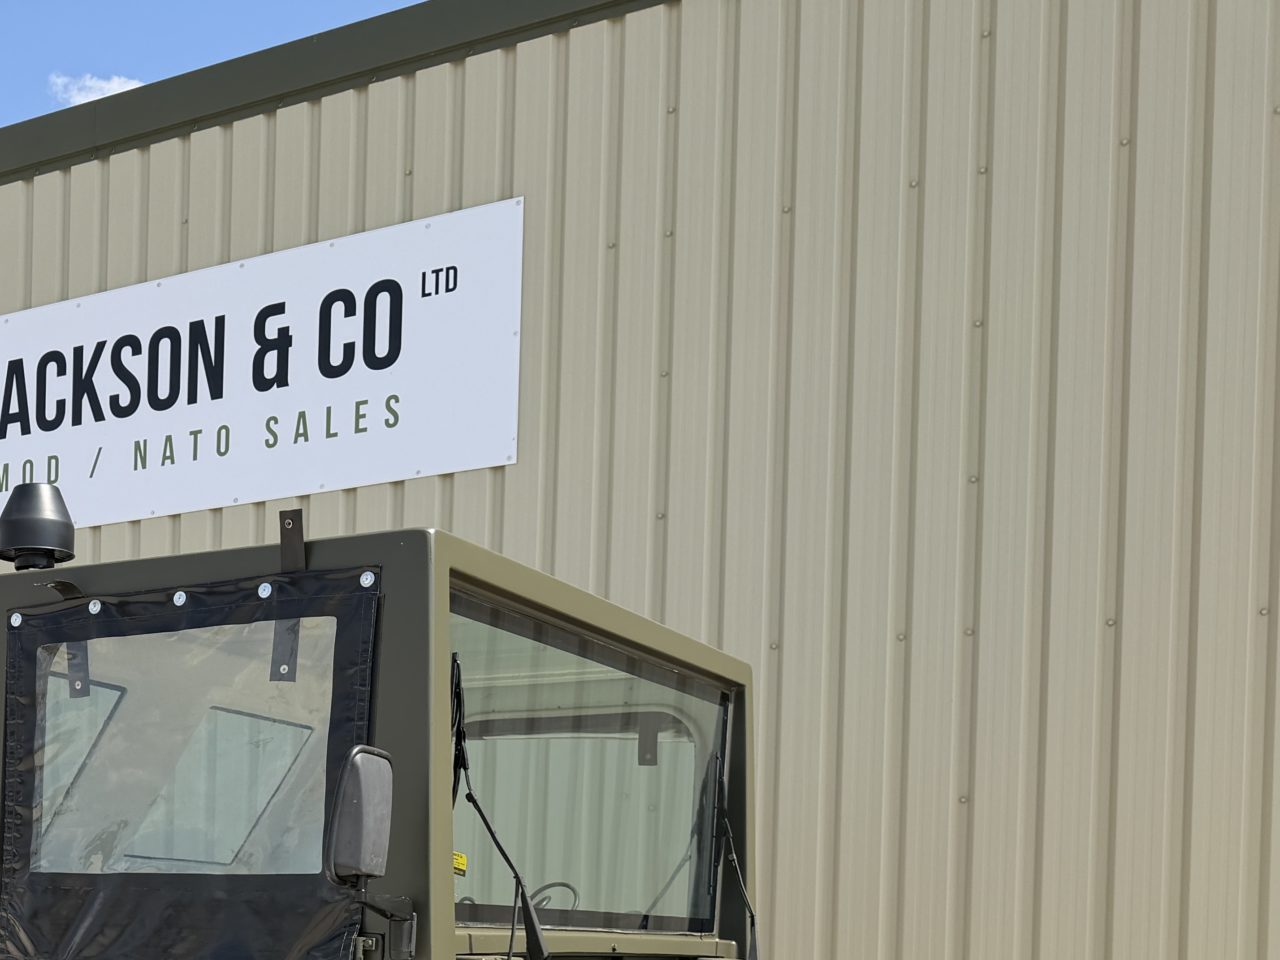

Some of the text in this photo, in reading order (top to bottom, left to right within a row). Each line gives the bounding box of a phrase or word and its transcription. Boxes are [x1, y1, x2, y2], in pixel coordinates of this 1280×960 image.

[251, 301, 293, 393] &
[317, 278, 404, 380] CO
[421, 265, 459, 299] LTD
[89, 446, 103, 479] /
[133, 424, 231, 472] NATO
[264, 394, 400, 449] SALES
